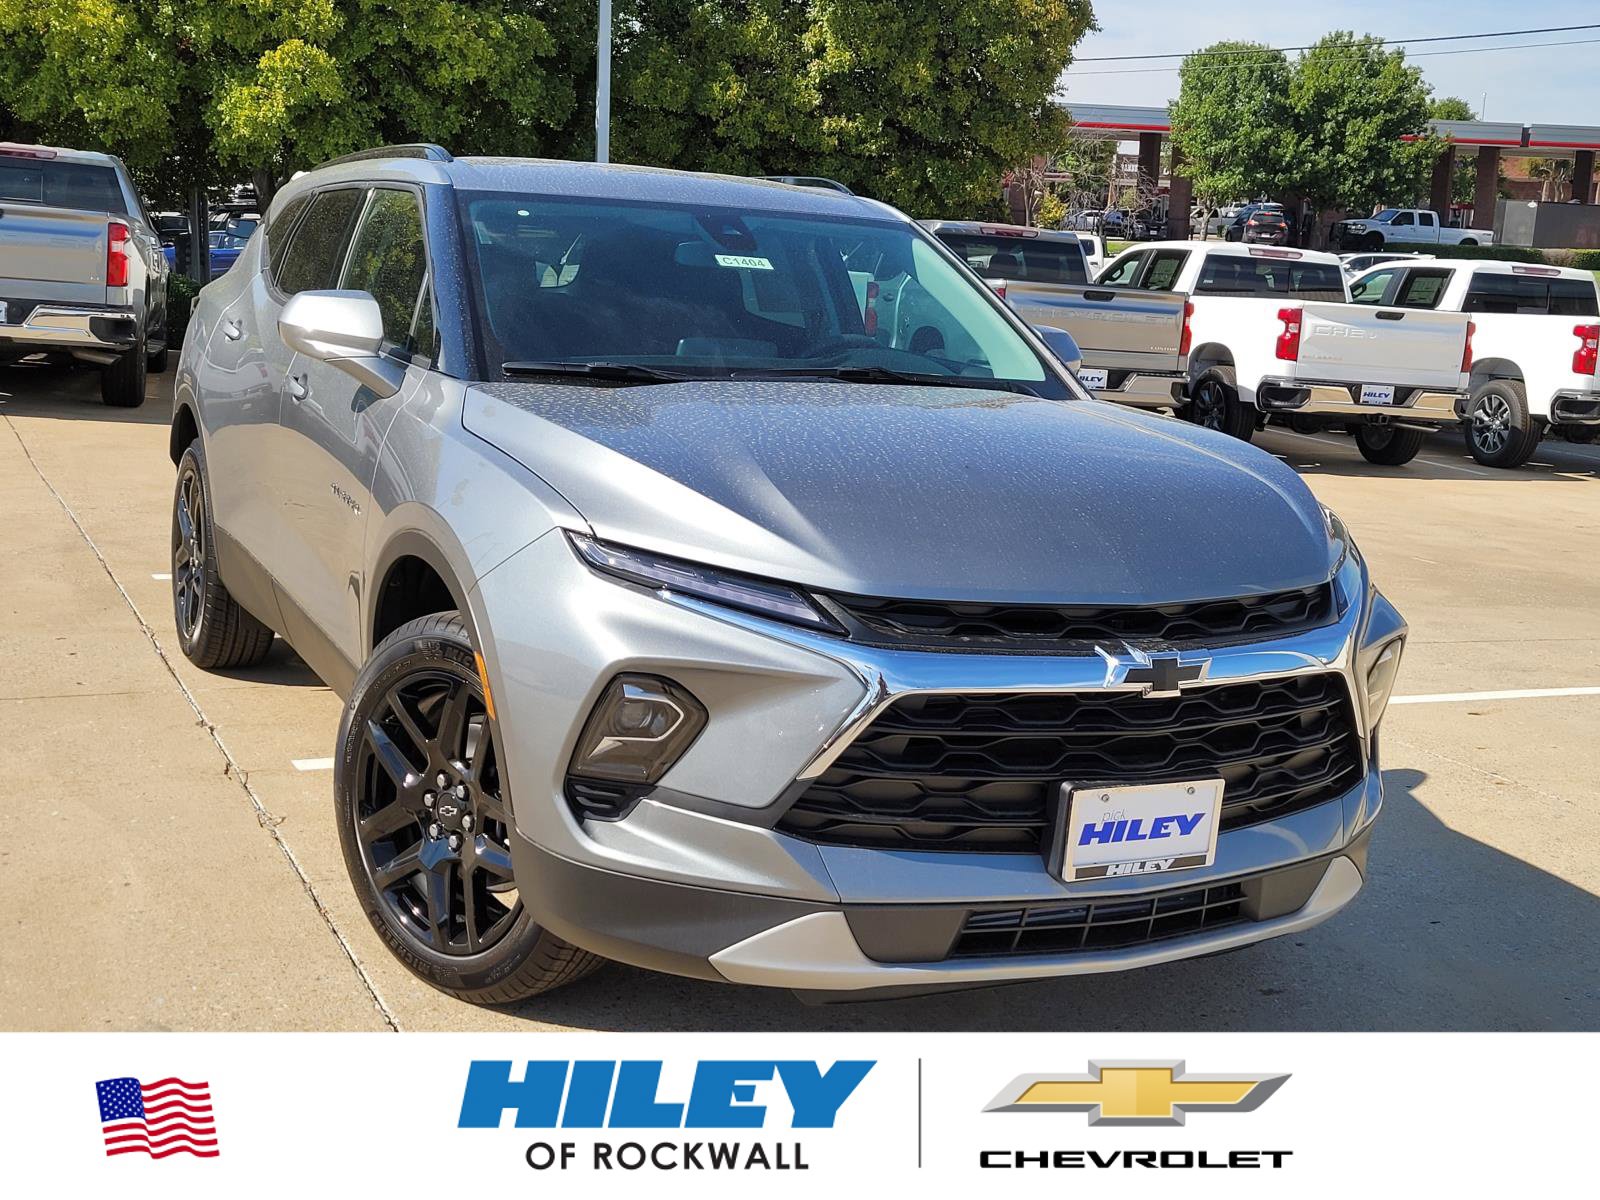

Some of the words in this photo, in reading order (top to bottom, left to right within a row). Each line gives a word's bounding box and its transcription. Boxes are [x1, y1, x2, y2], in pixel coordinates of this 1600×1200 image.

[722, 257, 766, 267] C1404
[1363, 391, 1390, 399] HILEY
[1078, 813, 1205, 845] HILEY
[1106, 859, 1175, 876] HILEY
